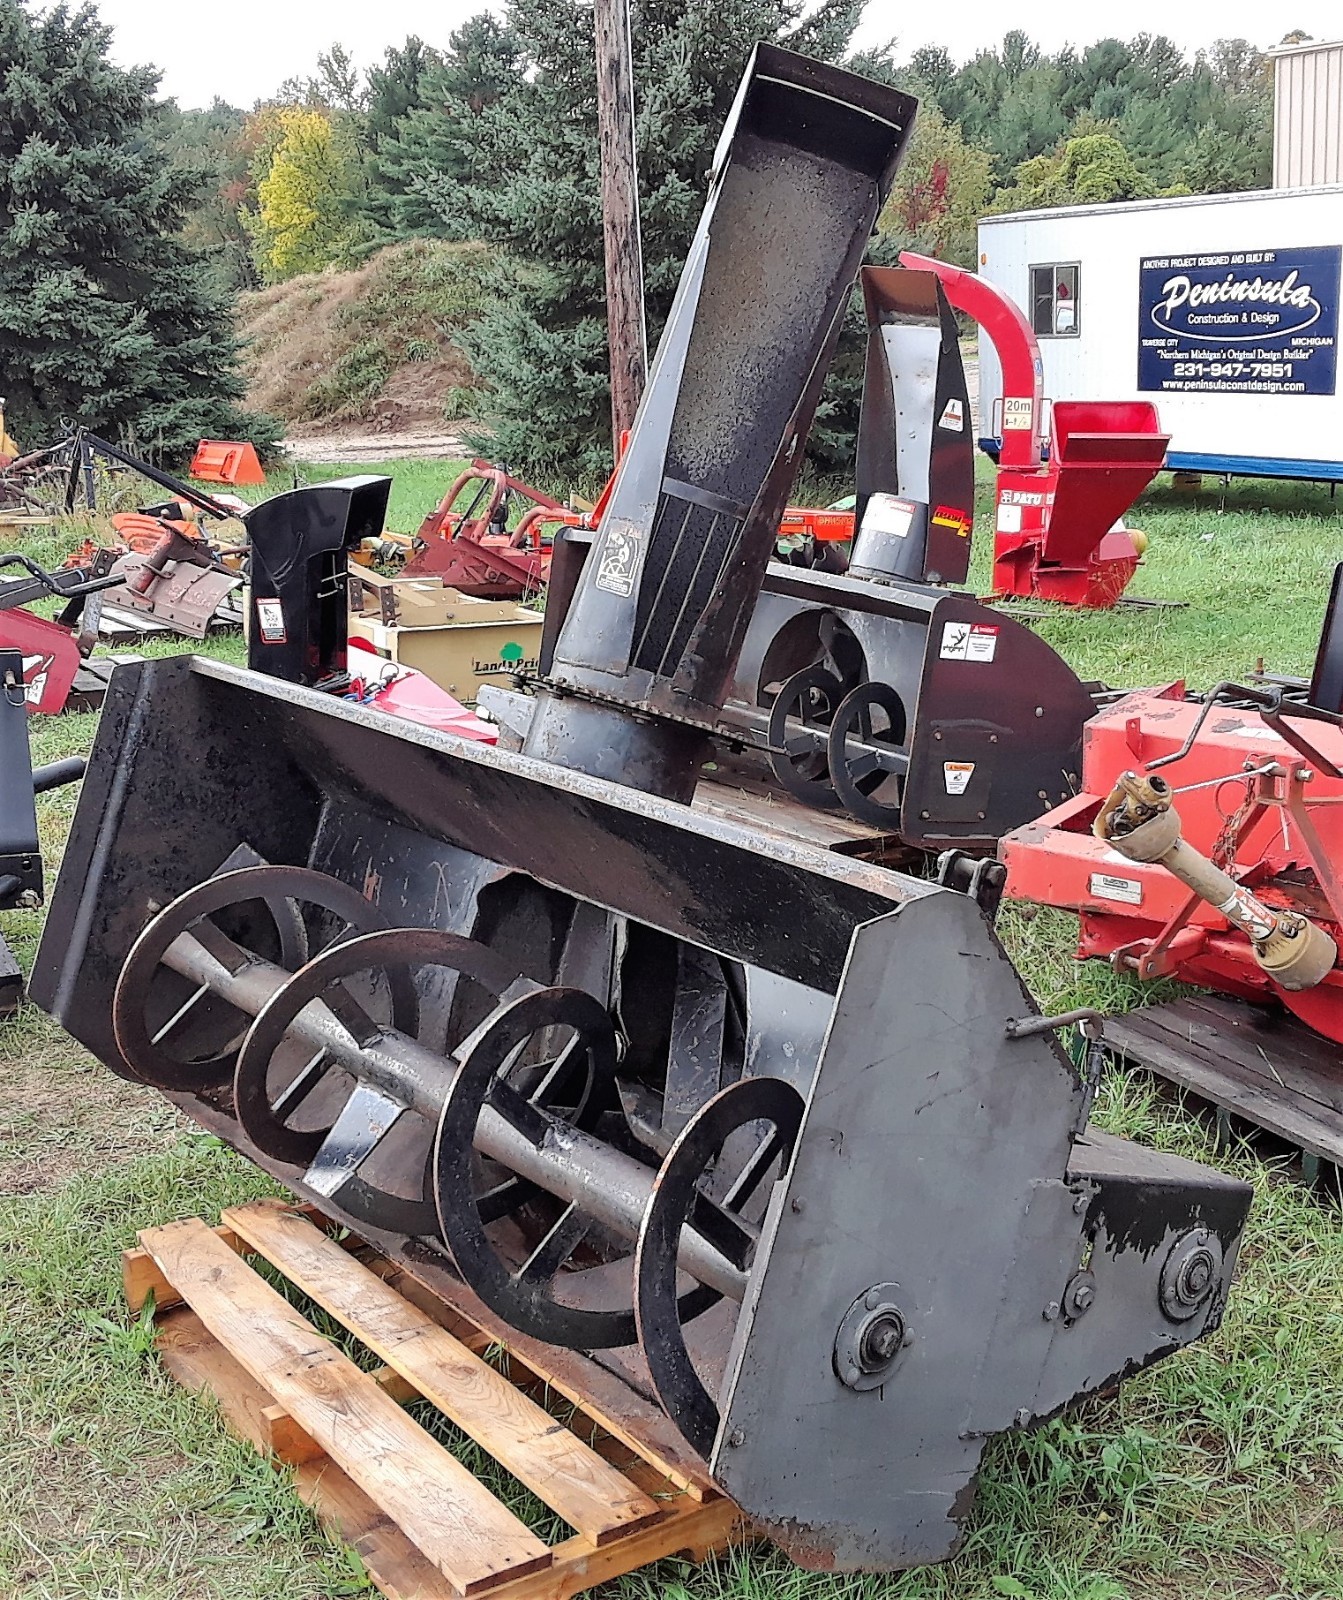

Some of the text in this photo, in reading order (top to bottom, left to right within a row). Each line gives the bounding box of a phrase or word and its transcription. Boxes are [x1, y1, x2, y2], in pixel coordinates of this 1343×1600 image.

[1143, 252, 1275, 269] ANOTHER PROJECT DESIGNED AND BUILT BY:
[1162, 270, 1311, 320] Peninsula
[1188, 311, 1280, 325] Construction & Design
[1167, 338, 1179, 347] CITY
[1291, 337, 1334, 346] MICHIGAN
[1190, 349, 1226, 361] Michigan's
[1227, 349, 1256, 361] Original
[1257, 349, 1282, 361] Design
[1173, 363, 1292, 378] 231-947-7951
[1162, 379, 1305, 393] www.peninsulaconstdesign.com
[1006, 400, 1031, 411] 20m
